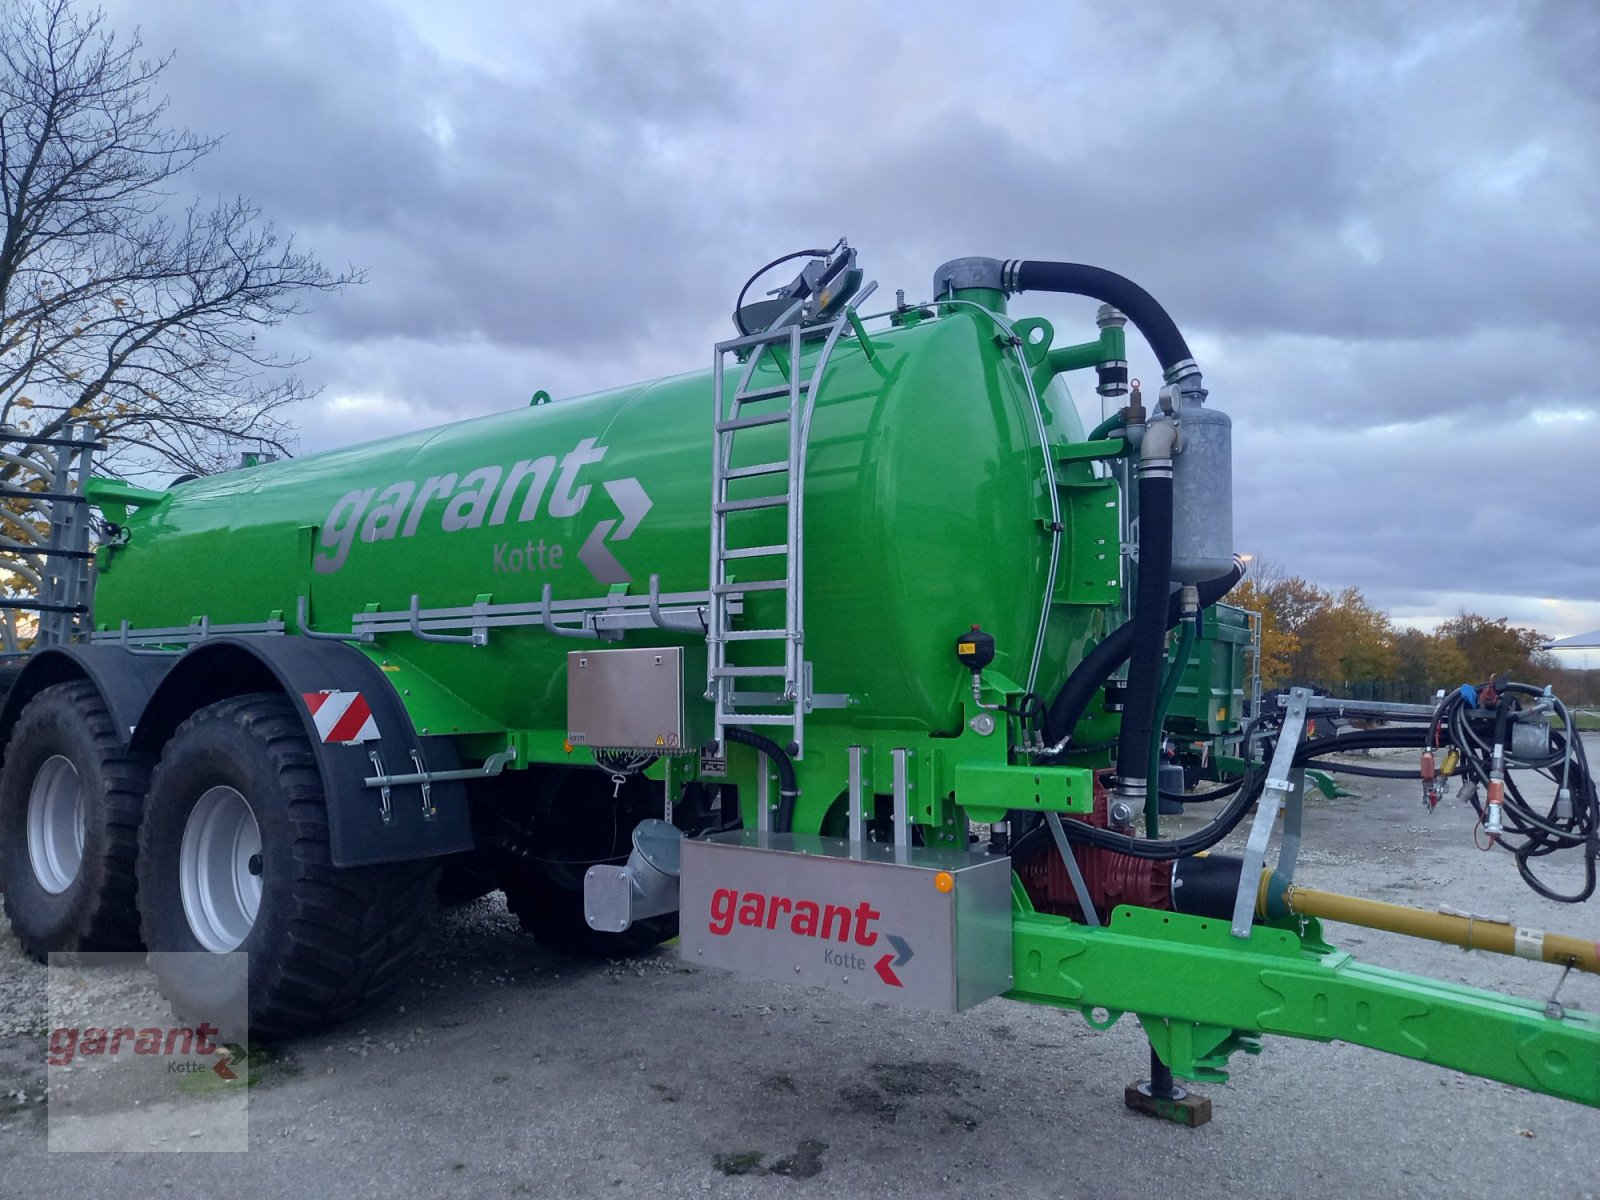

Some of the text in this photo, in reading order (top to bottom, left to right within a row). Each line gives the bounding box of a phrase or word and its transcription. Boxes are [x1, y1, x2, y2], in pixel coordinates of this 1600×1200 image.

[314, 437, 608, 574] garant
[492, 539, 563, 573] Kotte
[709, 888, 880, 946] garant
[824, 949, 865, 971] Kotte
